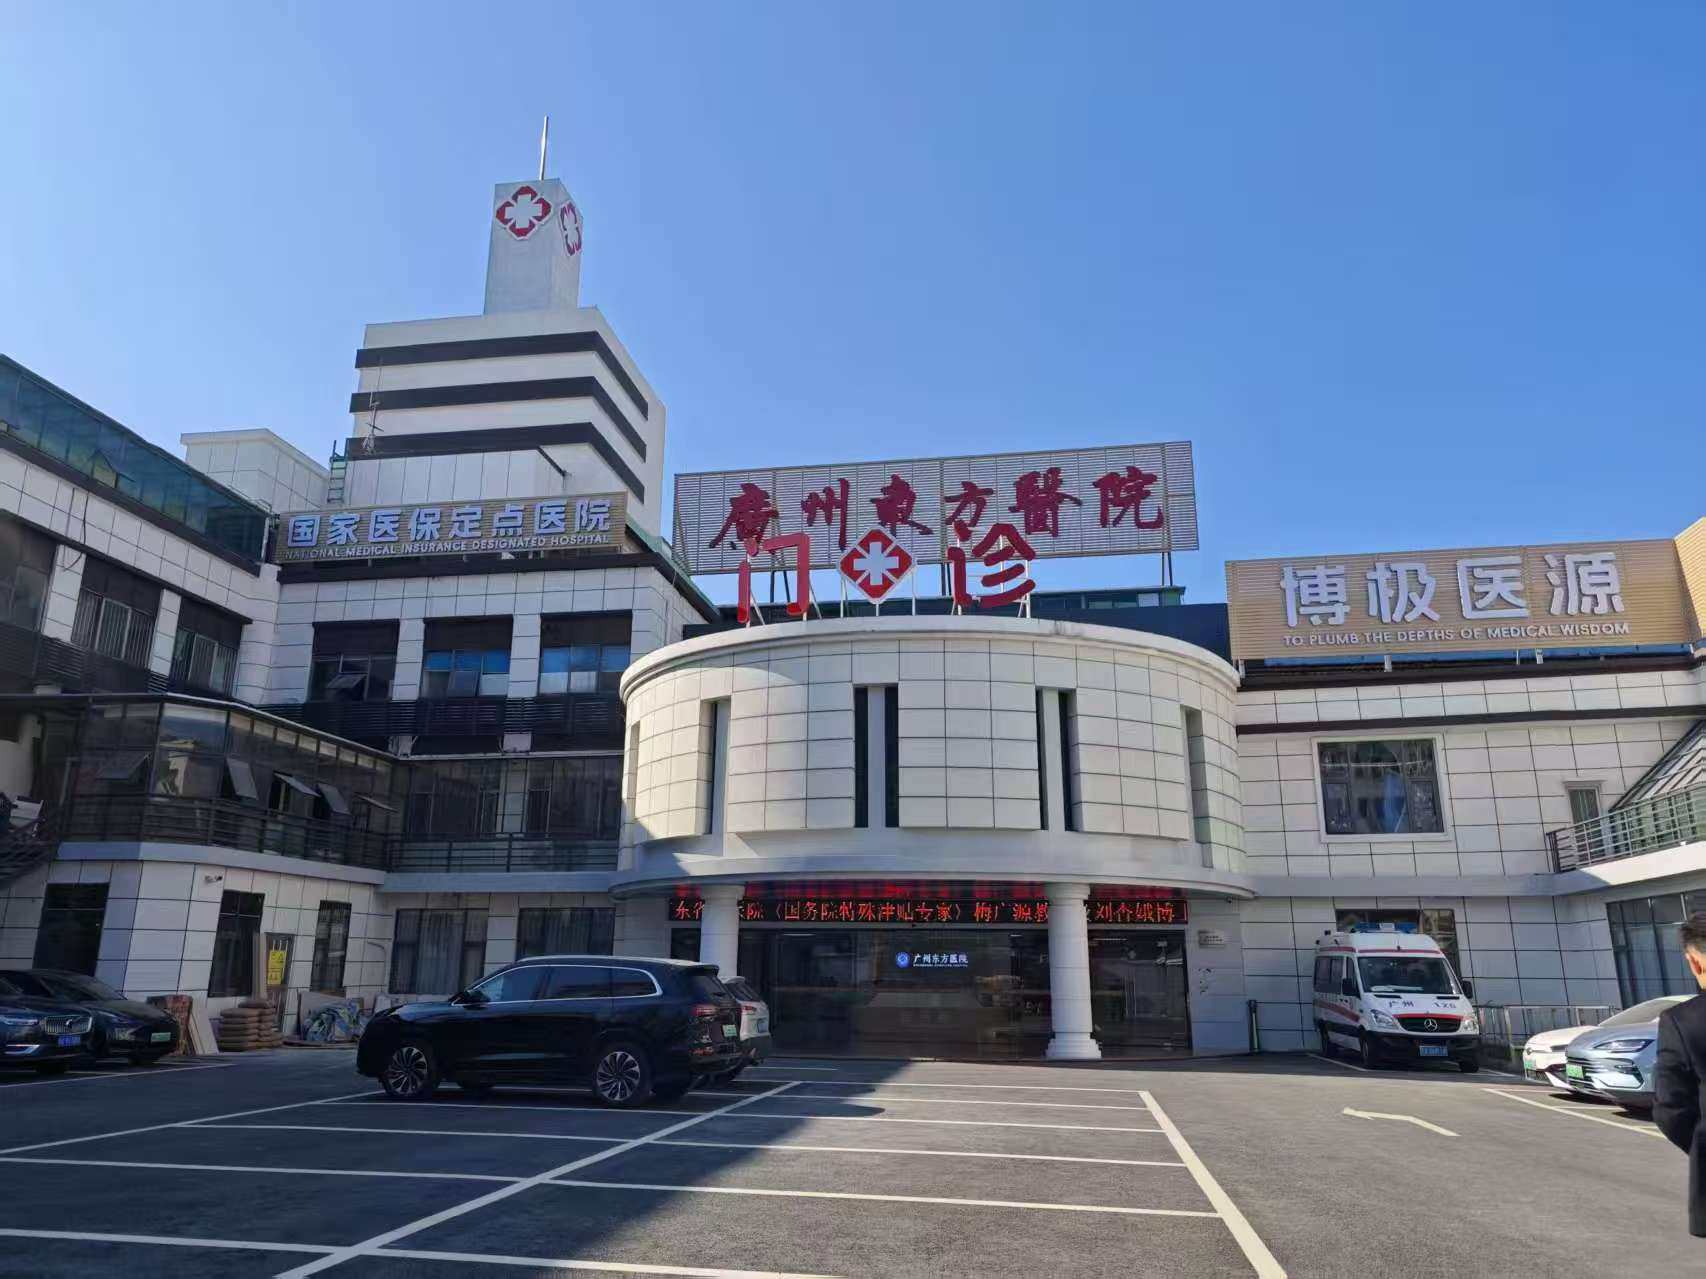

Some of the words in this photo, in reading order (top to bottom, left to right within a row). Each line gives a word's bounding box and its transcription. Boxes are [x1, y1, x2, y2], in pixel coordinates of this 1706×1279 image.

[287, 499, 611, 547] 国家医保定点医院
[285, 547, 343, 560] NATIONAL
[345, 544, 396, 557] MEDICAL
[400, 540, 467, 554] INSURANCE
[472, 536, 546, 550] DESIGNATED
[551, 534, 609, 546] HOSPITAL
[737, 522, 1037, 623] 门诊
[1279, 552, 1625, 627] 博极医源
[1283, 634, 1304, 646] TO
[1309, 632, 1359, 646] PLUMB
[1364, 629, 1392, 643] THE
[1397, 628, 1454, 642] DEPTHS
[1459, 627, 1480, 640] OF
[1487, 625, 1554, 639] MEDICAL
[1560, 622, 1630, 637] WISDOM
[912, 953, 969, 964] 广州东方医院
